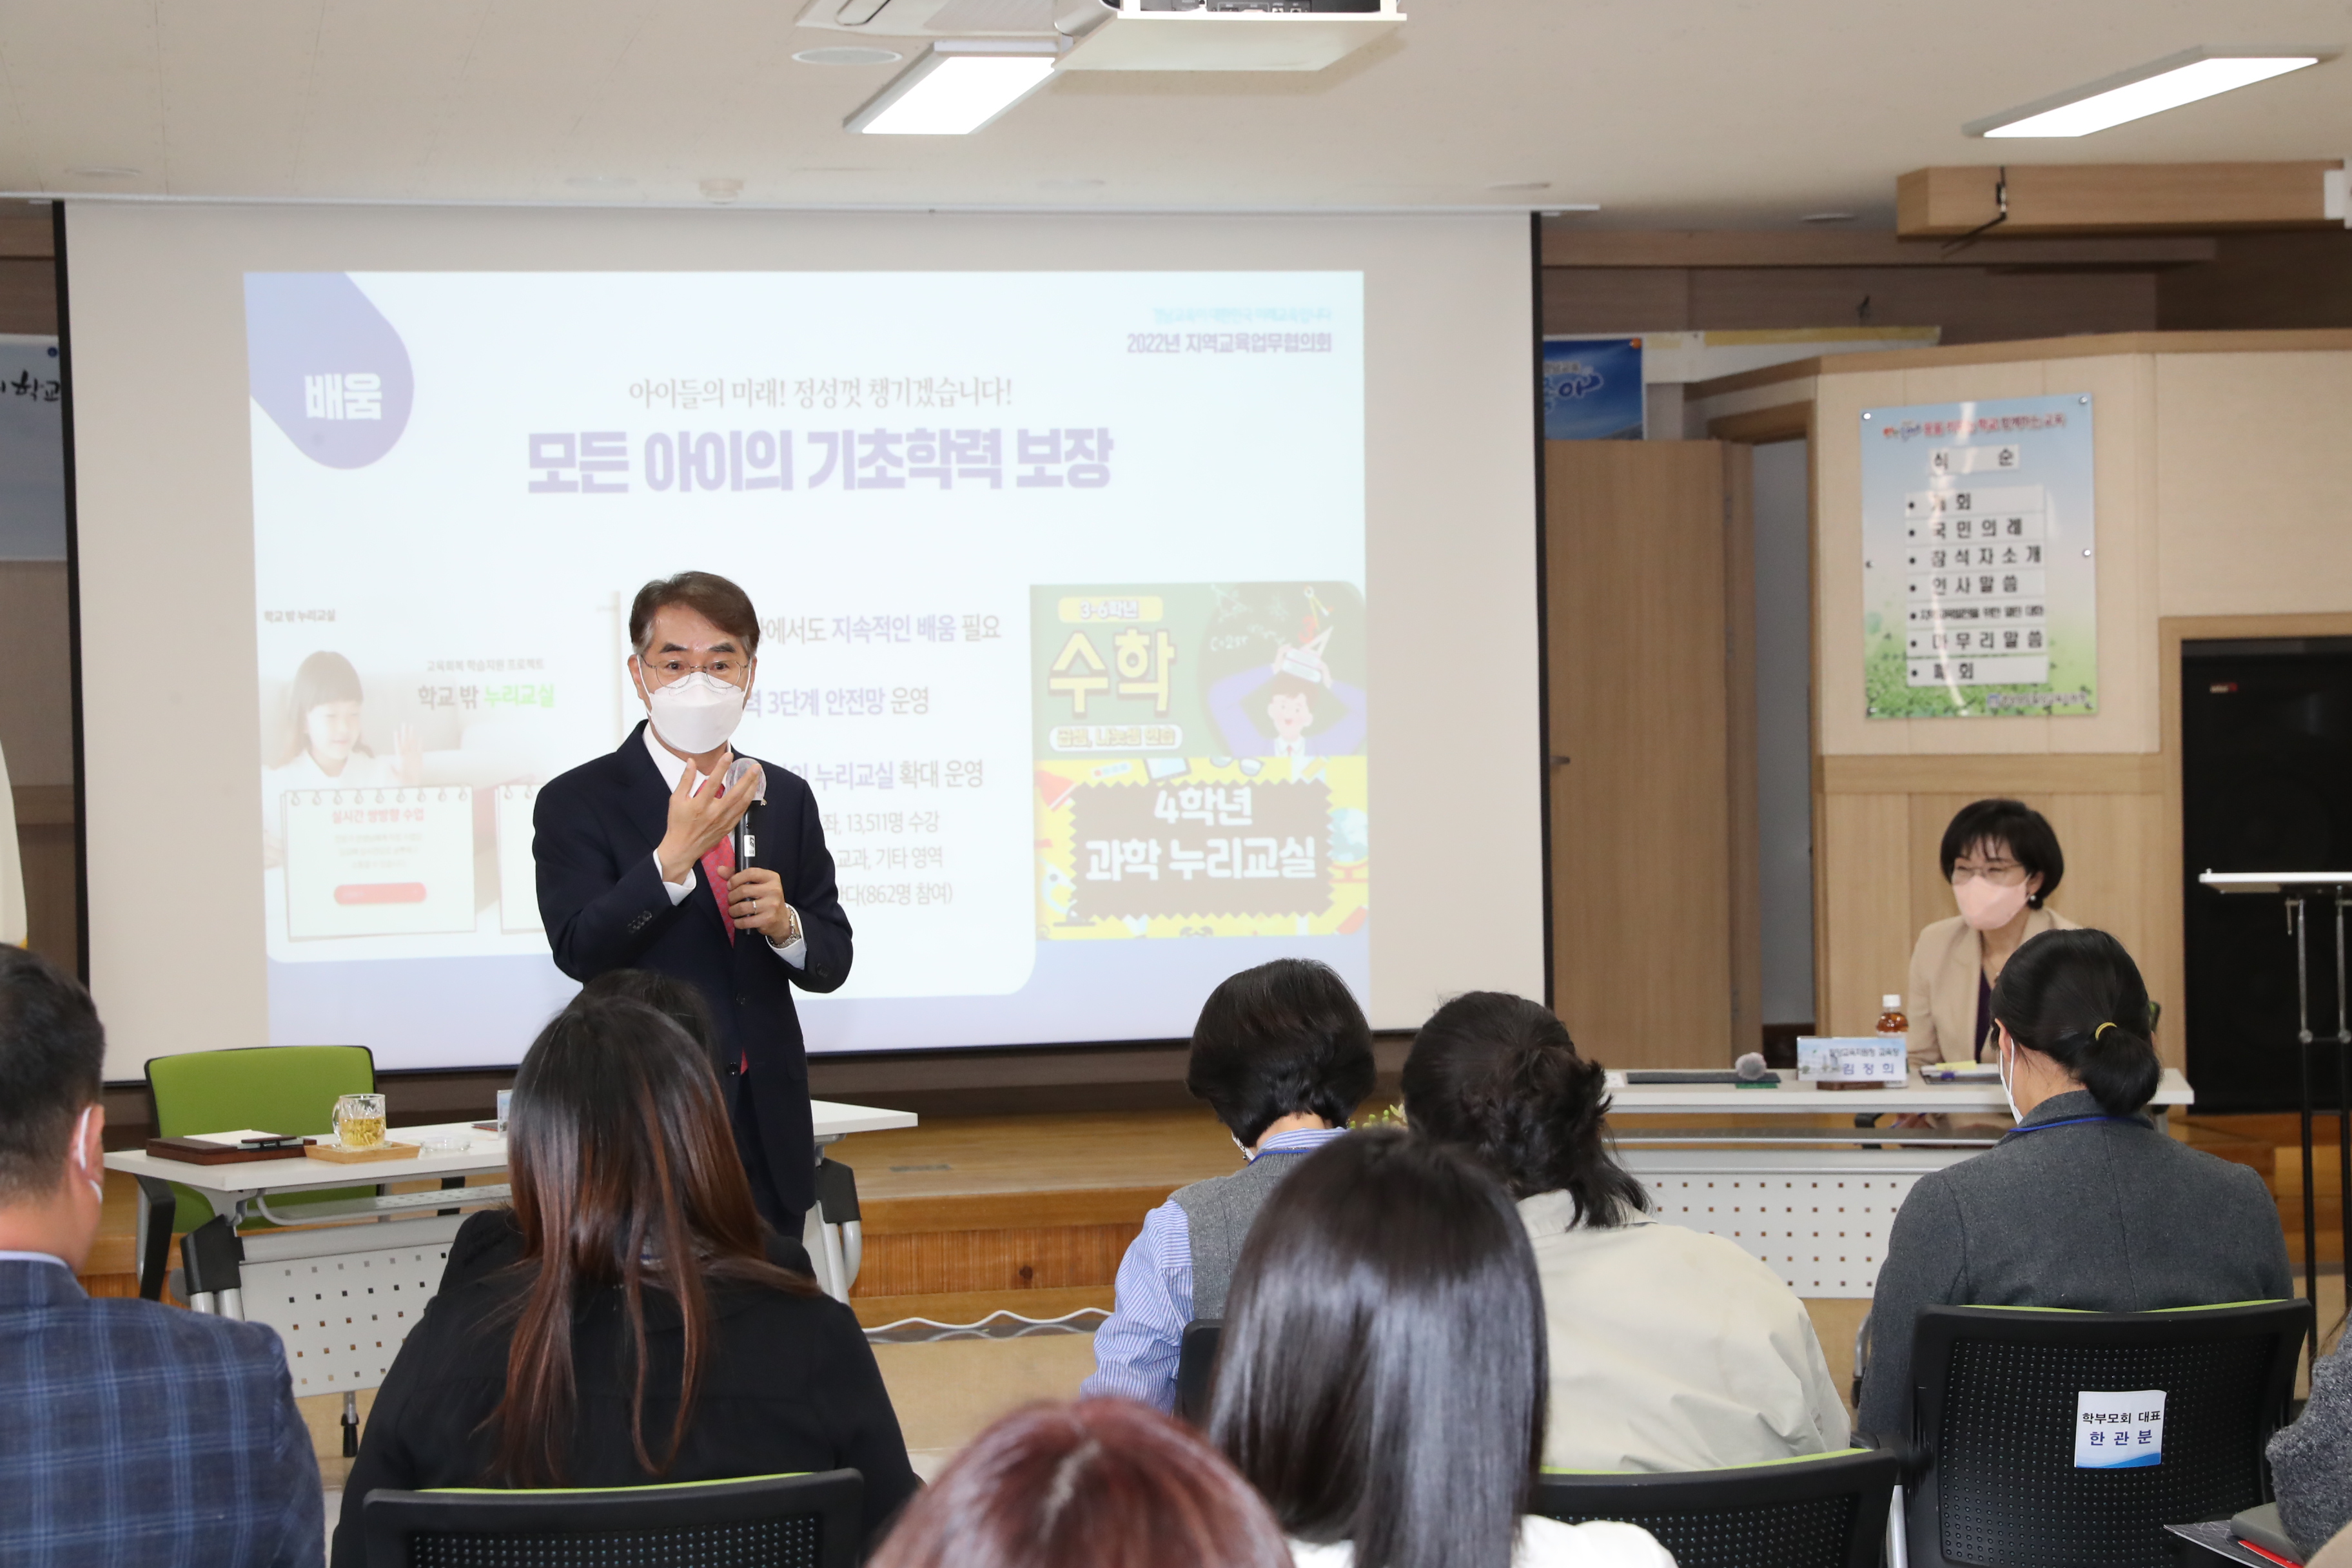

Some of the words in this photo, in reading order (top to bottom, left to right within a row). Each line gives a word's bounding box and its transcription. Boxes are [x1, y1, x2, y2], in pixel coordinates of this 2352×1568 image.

[1127, 333, 1181, 353] 2022년
[1186, 332, 1332, 353] 지역교육업무협의회
[304, 372, 382, 420] 배움
[629, 377, 724, 410] 아이들의
[732, 377, 786, 410] 미래!
[792, 377, 861, 410] 정성껏
[868, 375, 1012, 410] 챙기겠습니다!
[527, 431, 629, 495] 모든
[645, 429, 794, 493] 아이의
[807, 427, 1003, 491] 기초학력
[1016, 426, 1114, 489] 보장
[264, 611, 284, 623] 학교
[298, 609, 336, 623] 누리교실
[1080, 599, 1140, 620] 3-6학년
[832, 614, 912, 644] 지속적인
[917, 614, 957, 643] 배움
[961, 614, 1002, 642] 필요
[1049, 627, 1176, 718] 수학
[418, 684, 455, 710] 학교
[459, 684, 480, 710] 밖
[484, 683, 556, 709] 누리교실
[767, 688, 819, 717] 3단계
[826, 687, 885, 716] 안전망
[891, 685, 930, 714] 운영
[815, 761, 894, 790] 누리교실
[899, 760, 939, 789] 확대
[945, 760, 984, 789] 운영
[332, 810, 364, 825] 실시간
[404, 807, 424, 823] 수업
[1154, 787, 1253, 827] 4학년
[847, 811, 903, 835] 13,511명
[908, 810, 940, 834] 수강
[836, 847, 872, 871] 교과,
[876, 847, 908, 870] 기타
[912, 846, 944, 869] 영역
[1085, 837, 1162, 882] 과학
[1168, 836, 1317, 881] 누리교실
[916, 882, 954, 905] 참여)
[2082, 1411, 2132, 1425] 학부모회
[2138, 1410, 2162, 1424] 대표
